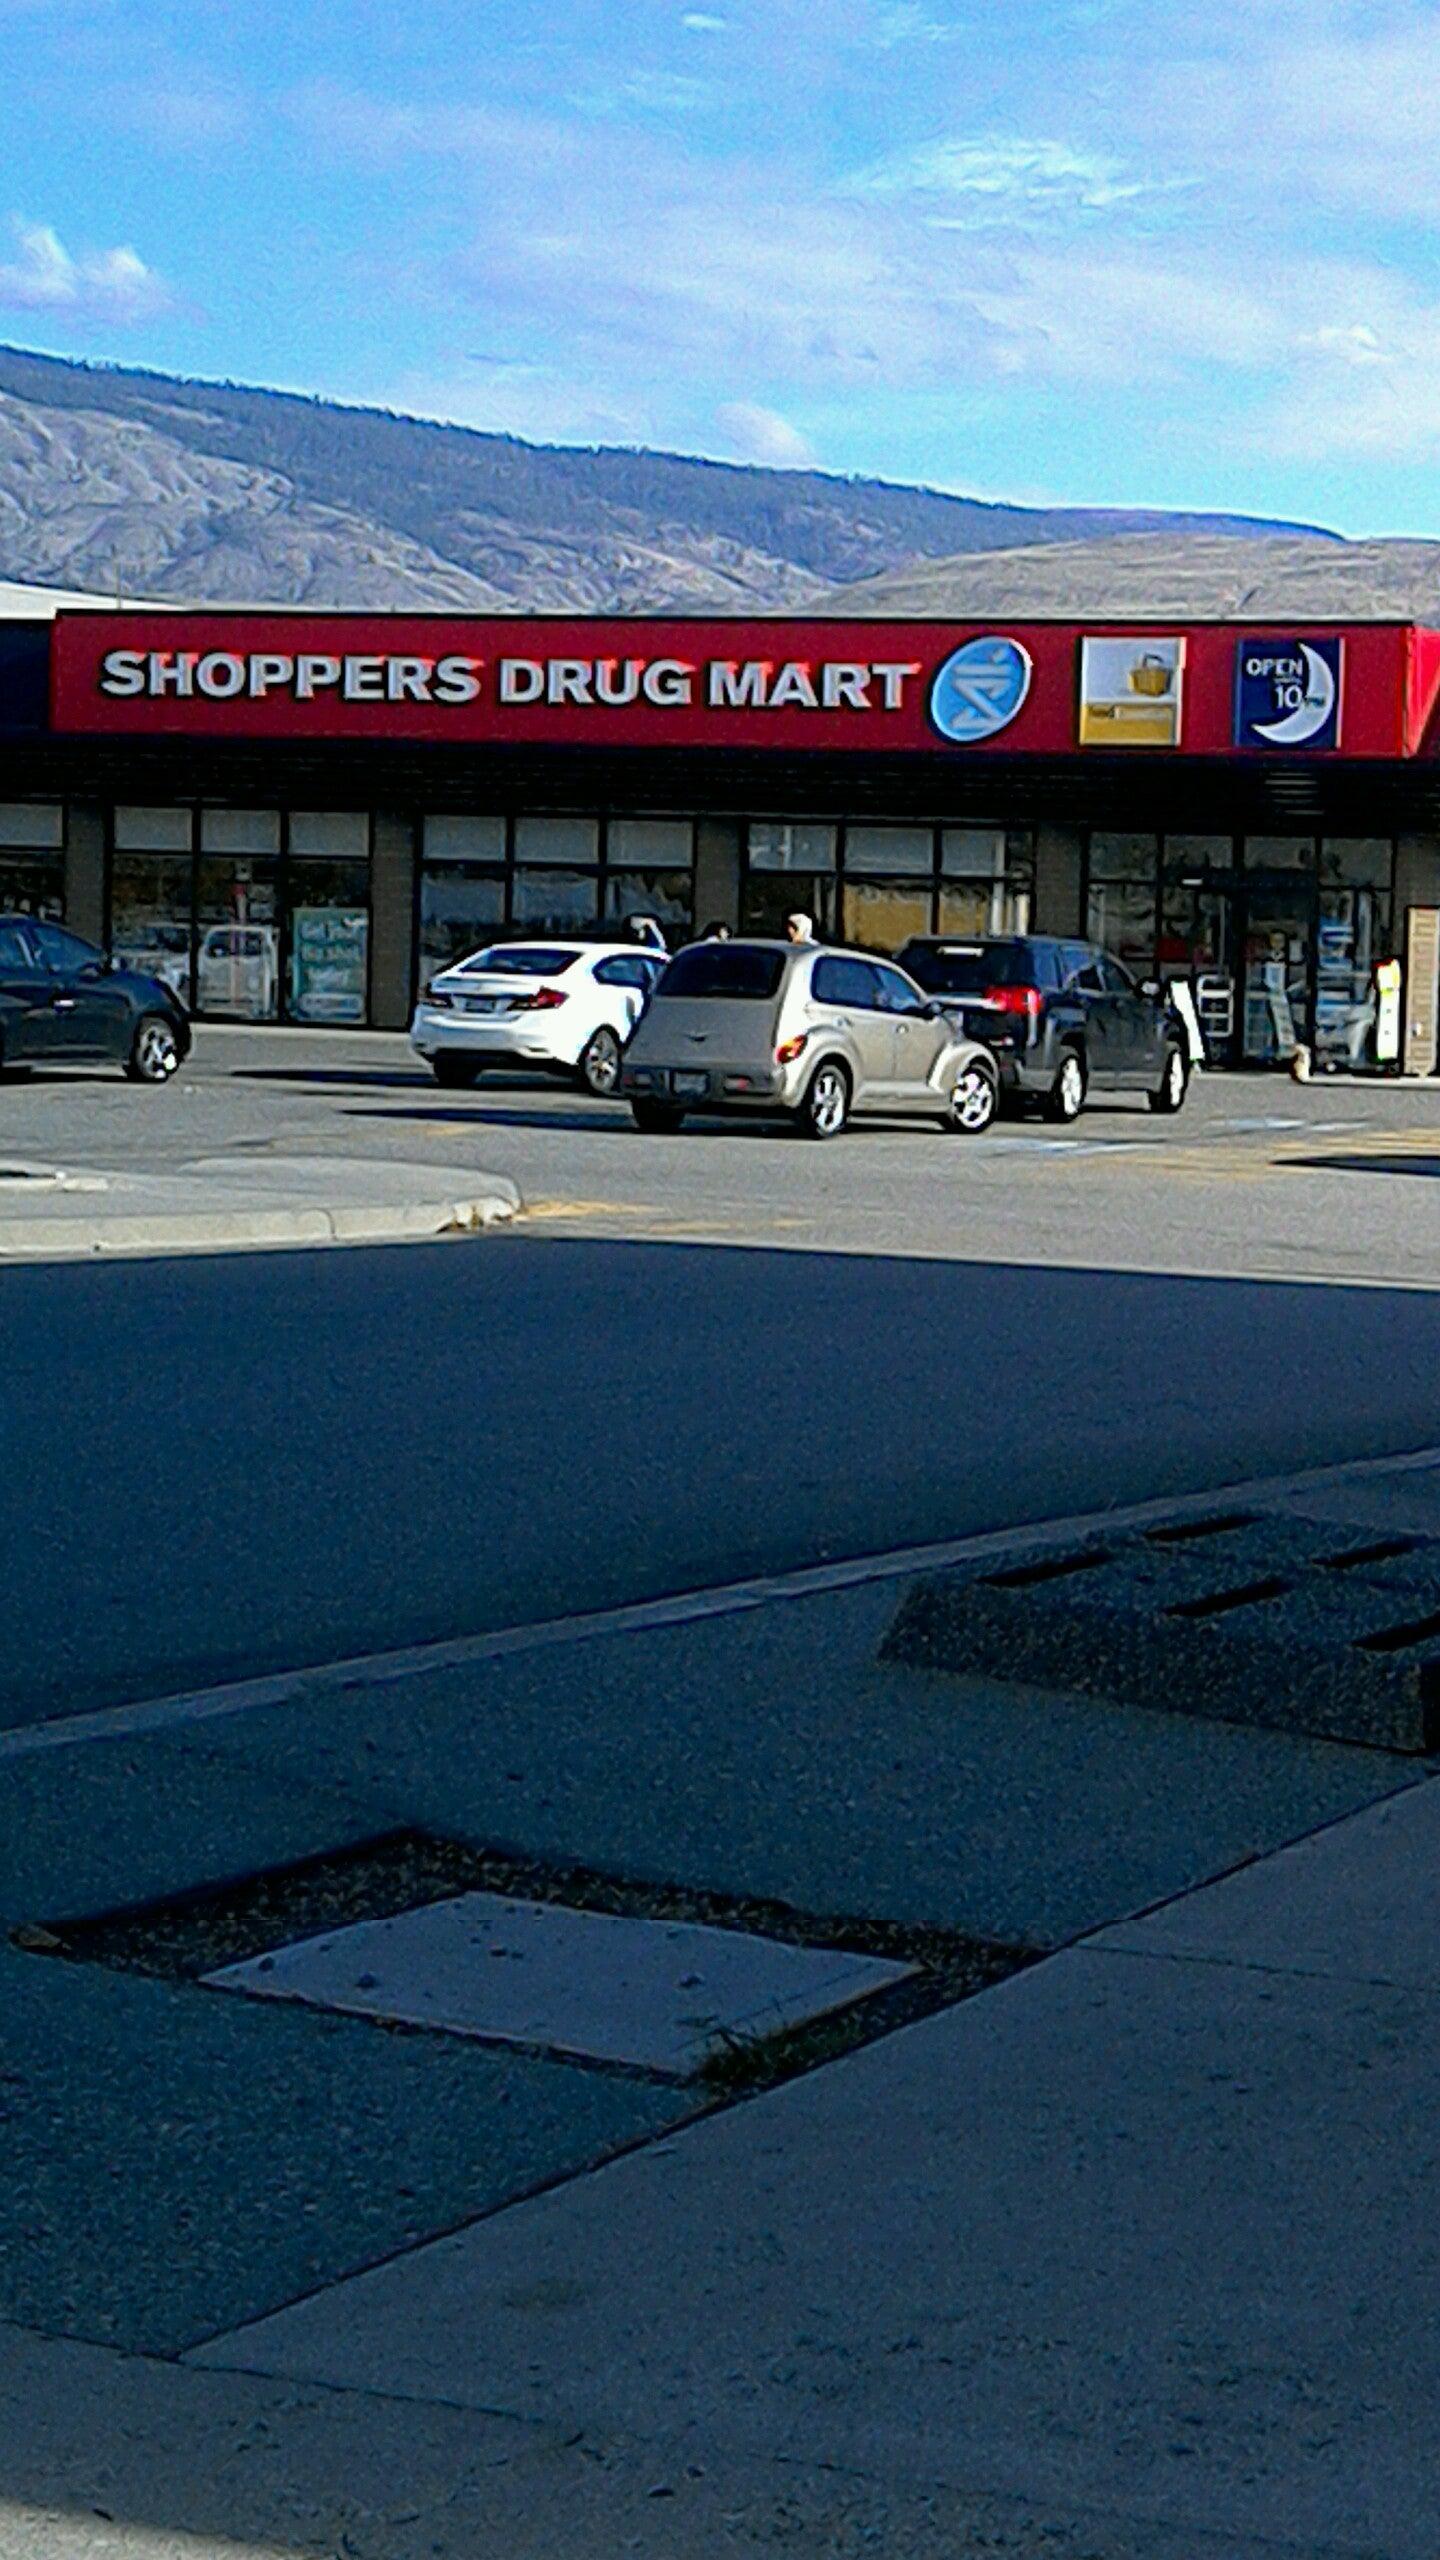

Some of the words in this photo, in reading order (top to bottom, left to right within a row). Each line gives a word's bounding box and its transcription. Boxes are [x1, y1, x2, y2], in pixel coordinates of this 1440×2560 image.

[102, 650, 483, 702] SHOPPERS
[500, 658, 694, 705] DRUG
[708, 660, 920, 708] MART
[1245, 657, 1303, 677] OPEN
[1273, 685, 1303, 709] 10
